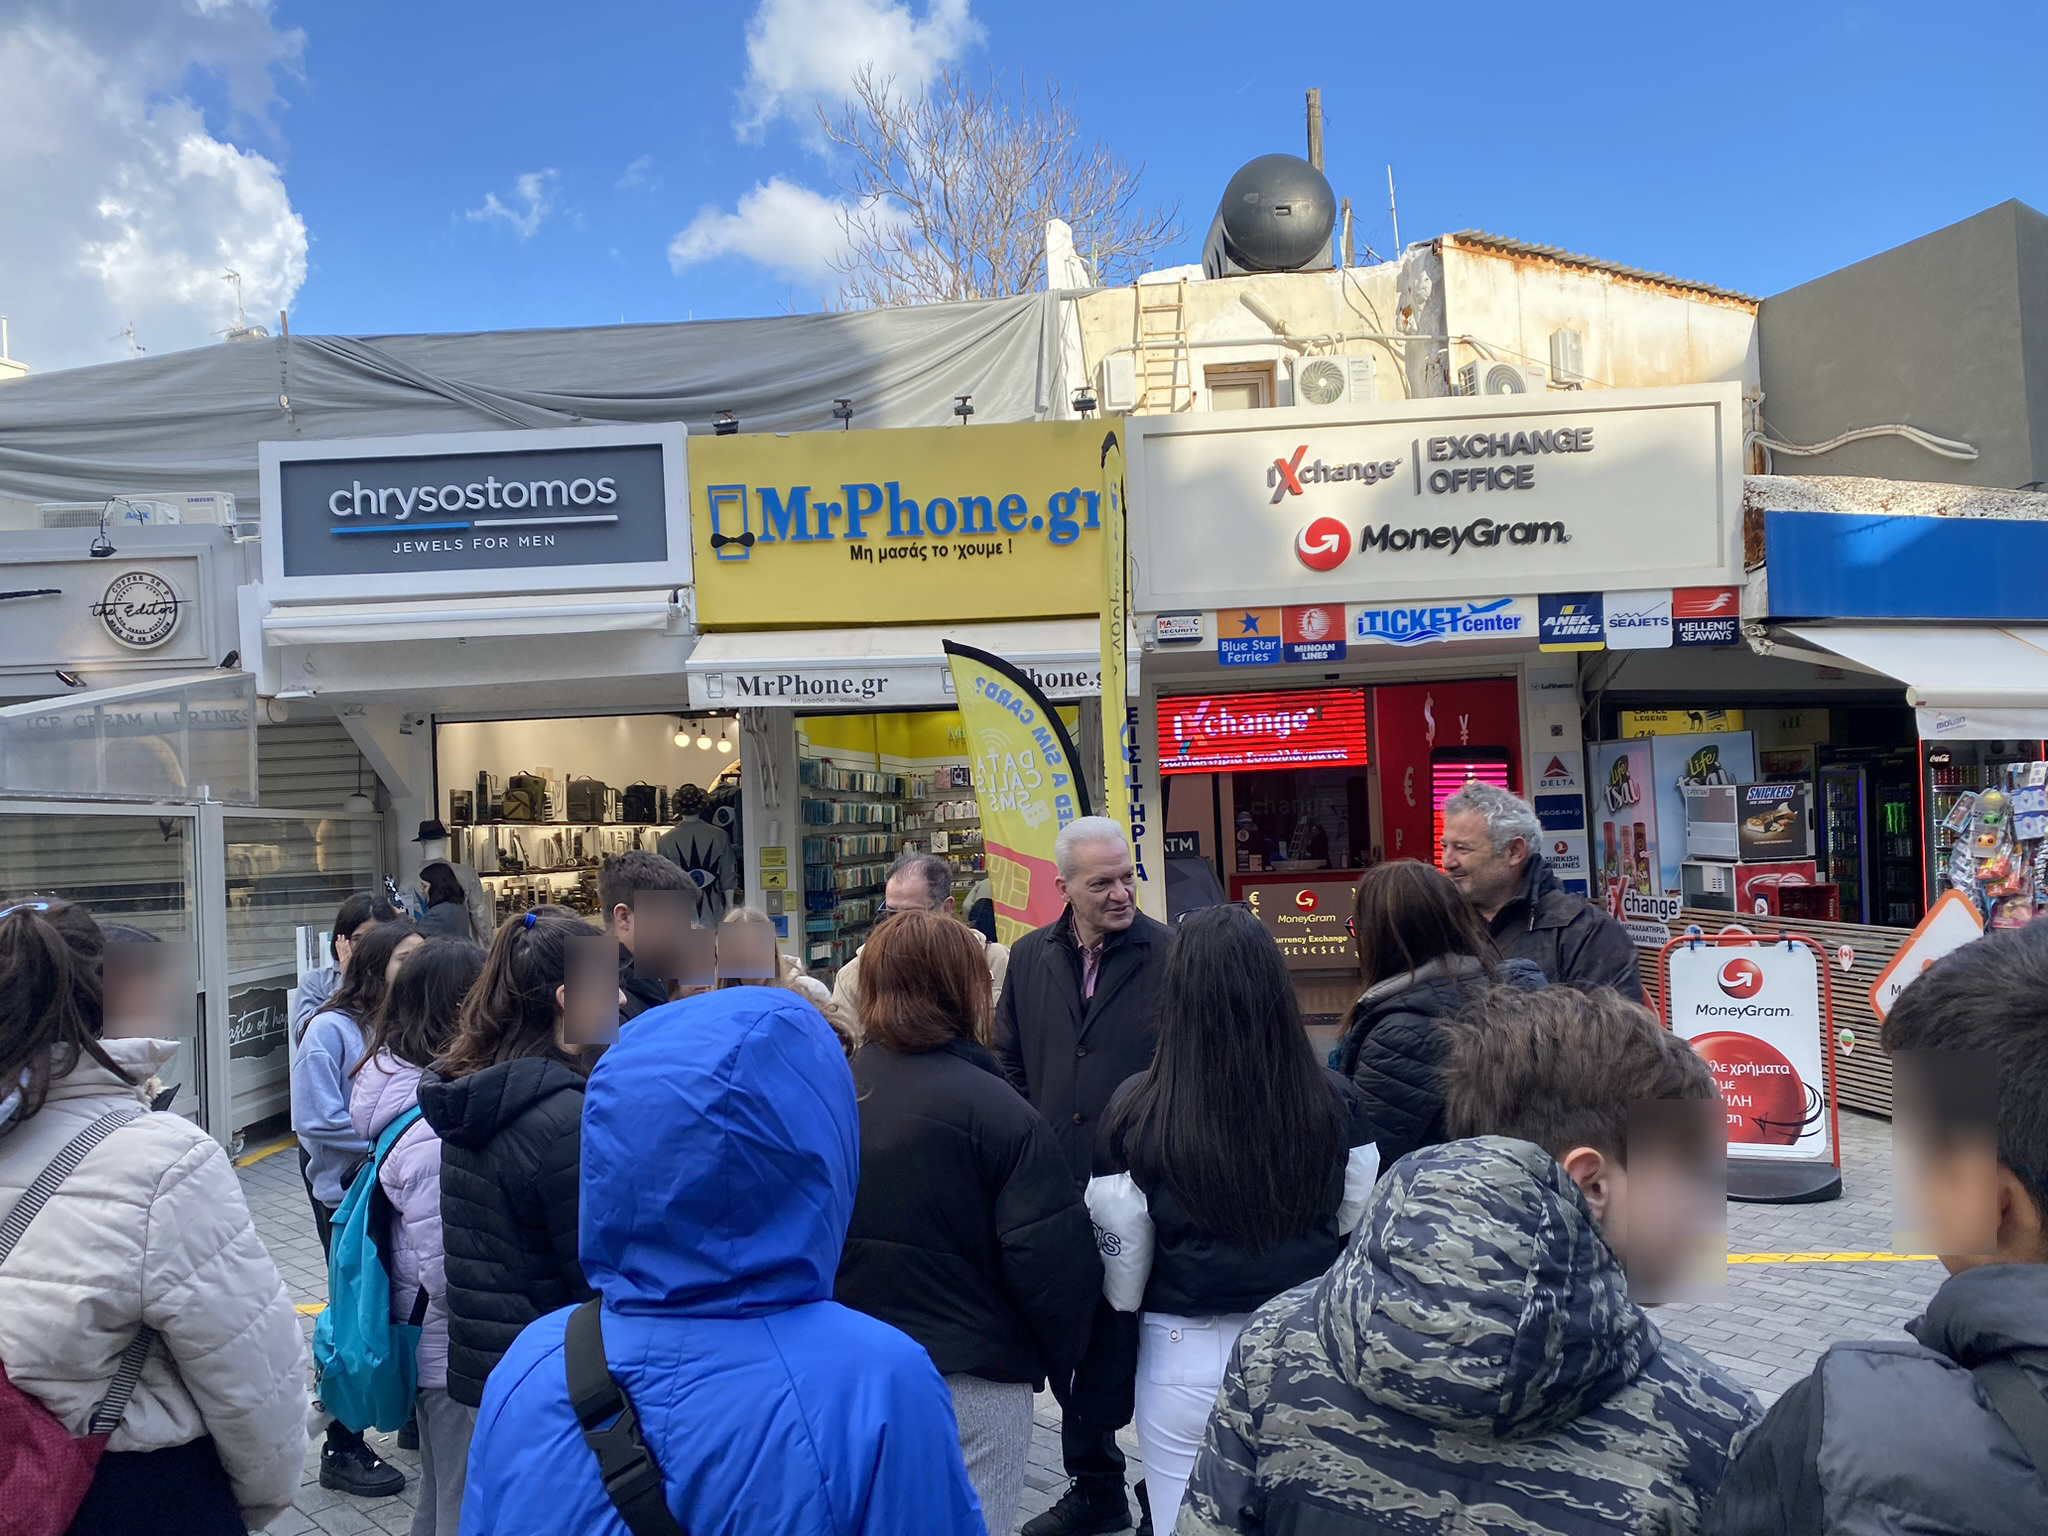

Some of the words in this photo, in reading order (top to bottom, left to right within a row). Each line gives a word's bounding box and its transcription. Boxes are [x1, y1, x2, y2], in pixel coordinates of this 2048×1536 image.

[1427, 426, 1595, 462] EXCHANGE
[1267, 444, 1397, 504] iXchange
[1427, 464, 1535, 494] OFFICE
[329, 476, 618, 520] chrysostomos
[755, 480, 1100, 546] MrPhone.gr
[393, 539, 464, 554] JEWELS
[473, 537, 508, 550] FOR
[518, 534, 556, 548] MEN
[850, 544, 873, 563] Μη
[878, 542, 927, 563] μασάς
[931, 545, 949, 557] το
[111, 575, 144, 594] COFFEE
[150, 578, 170, 596] SHP
[89, 602, 118, 617] the
[124, 600, 178, 617] Editor
[1463, 615, 1522, 632] center
[1542, 614, 1594, 626] ANEK
[1608, 616, 1670, 628] SEAJETS
[1679, 620, 1735, 632] HELLENIC
[1552, 624, 1602, 636] LINES
[1681, 630, 1733, 641] SEAWAYS
[1221, 639, 1248, 652] Blue
[1252, 640, 1276, 651] Star
[1294, 643, 1335, 653] MINOAN
[1227, 651, 1270, 663] Ferries
[1302, 651, 1328, 660] LINES
[735, 674, 889, 699] MrPhone.gr
[1027, 668, 1102, 690] hone.
[1540, 778, 1575, 787] DELTA
[1747, 785, 1795, 800] SNICKERS
[1277, 913, 1336, 925] MoneyGram
[1308, 934, 1348, 943] Exchange
[1695, 1003, 1791, 1019] MoneyGram
[1708, 1059, 1728, 1073] ίλε
[1729, 1061, 1791, 1076] χρήματα
